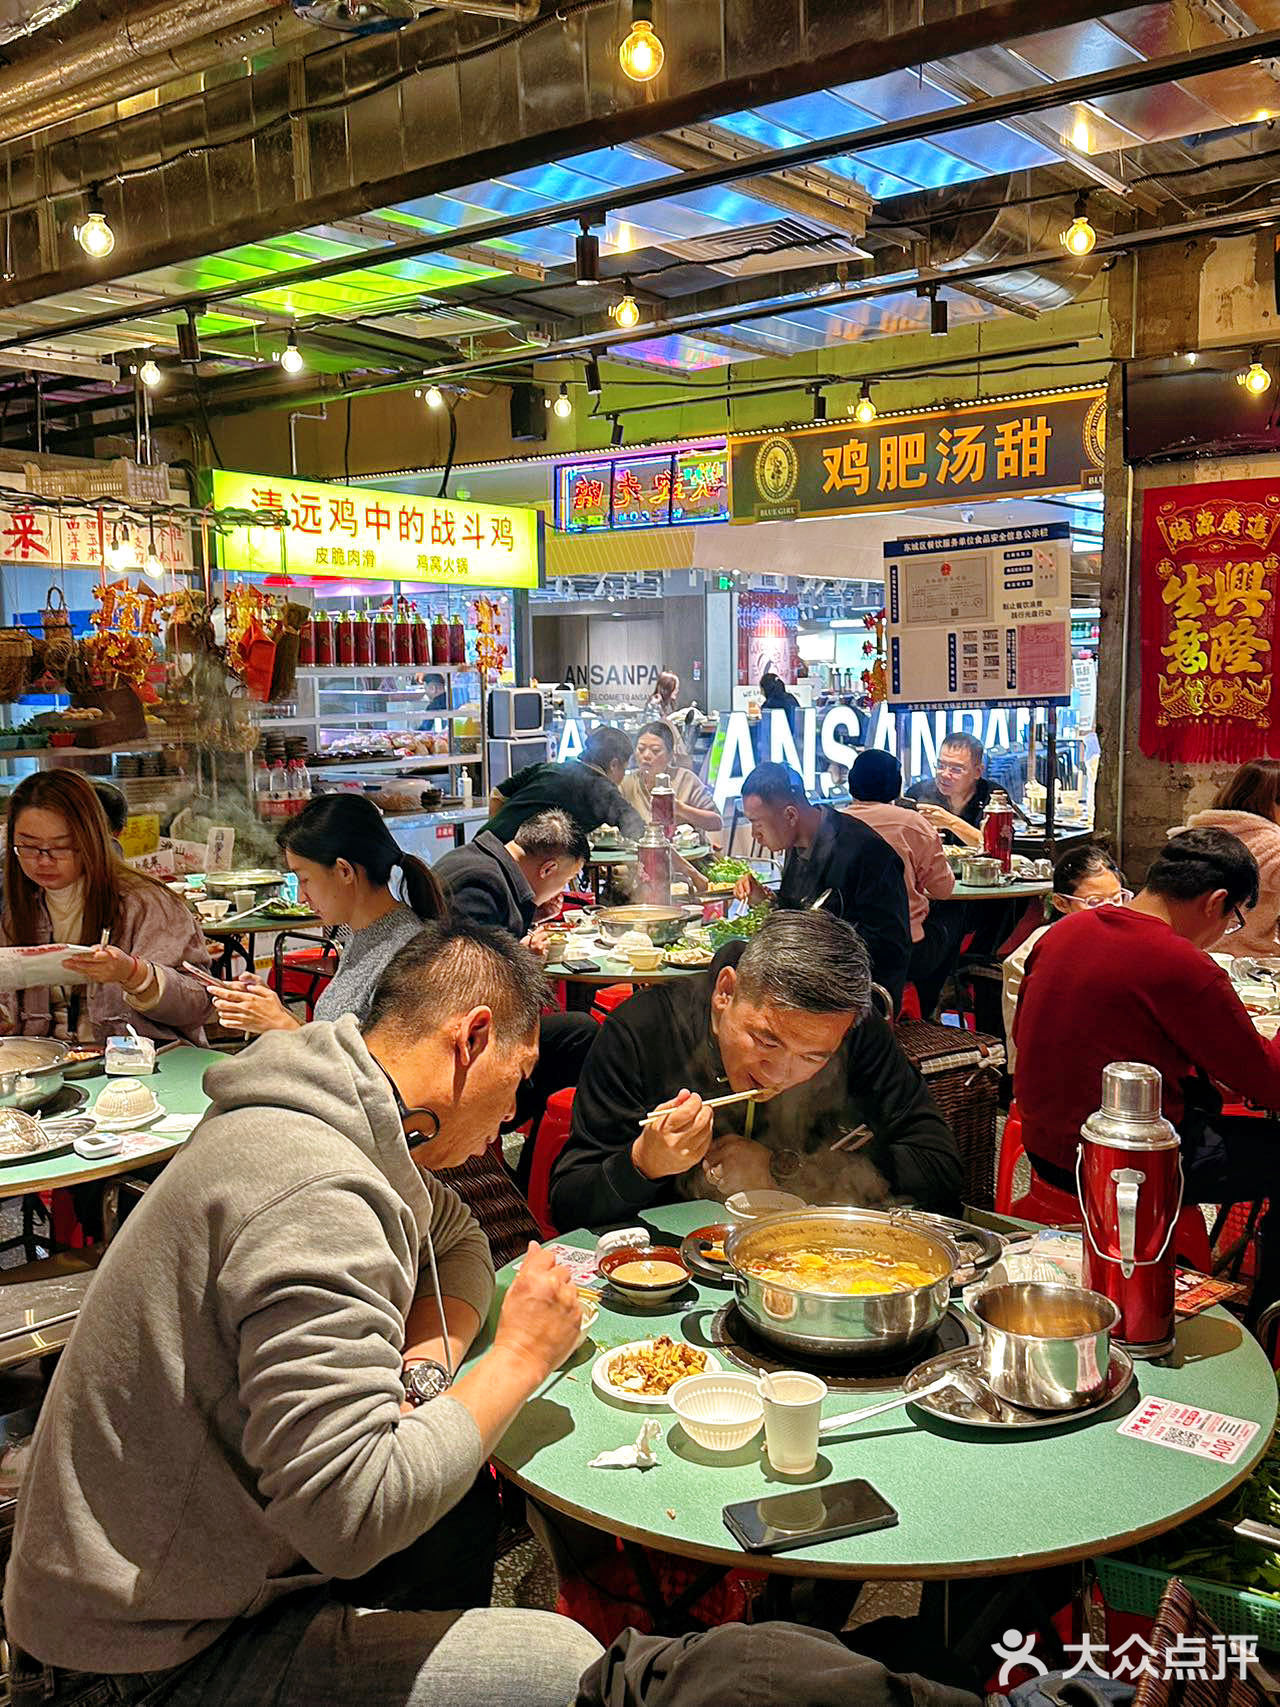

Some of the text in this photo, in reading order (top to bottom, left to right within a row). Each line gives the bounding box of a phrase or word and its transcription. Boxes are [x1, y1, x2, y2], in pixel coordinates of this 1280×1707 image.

[821, 416, 1052, 496] 鸡肥汤甜
[251, 487, 514, 552] 清远鸡中的战斗鸡
[760, 506, 796, 517] BLUE GIRL
[315, 547, 376, 568] 皮脆肉滑
[416, 554, 469, 575] 鸡窝火锅
[566, 665, 666, 686] ANSANPA
[1207, 1438, 1236, 1460] A08
